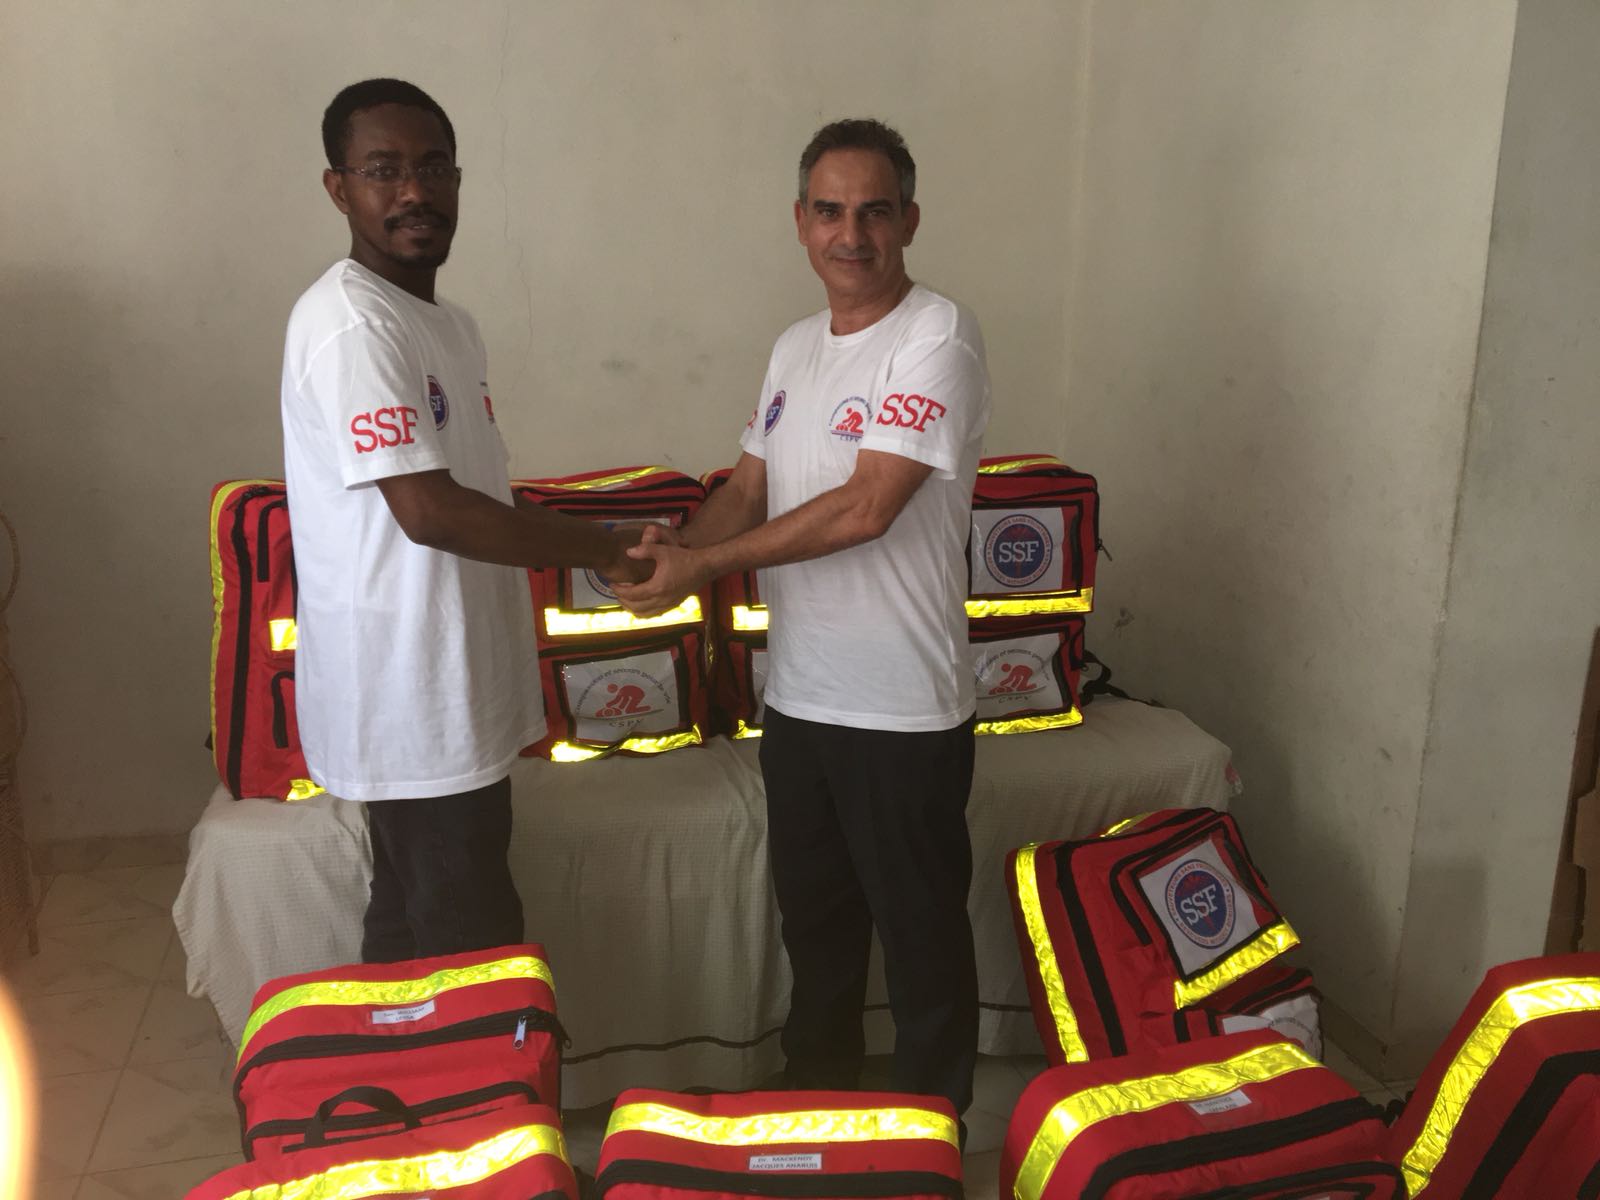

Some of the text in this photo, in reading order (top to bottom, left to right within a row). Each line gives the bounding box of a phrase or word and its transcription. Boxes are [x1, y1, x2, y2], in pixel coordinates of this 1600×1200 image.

[350, 406, 418, 454] SSF
[876, 393, 946, 432] SSF
[998, 541, 1039, 563] SSF
[1180, 884, 1218, 926] SSF
